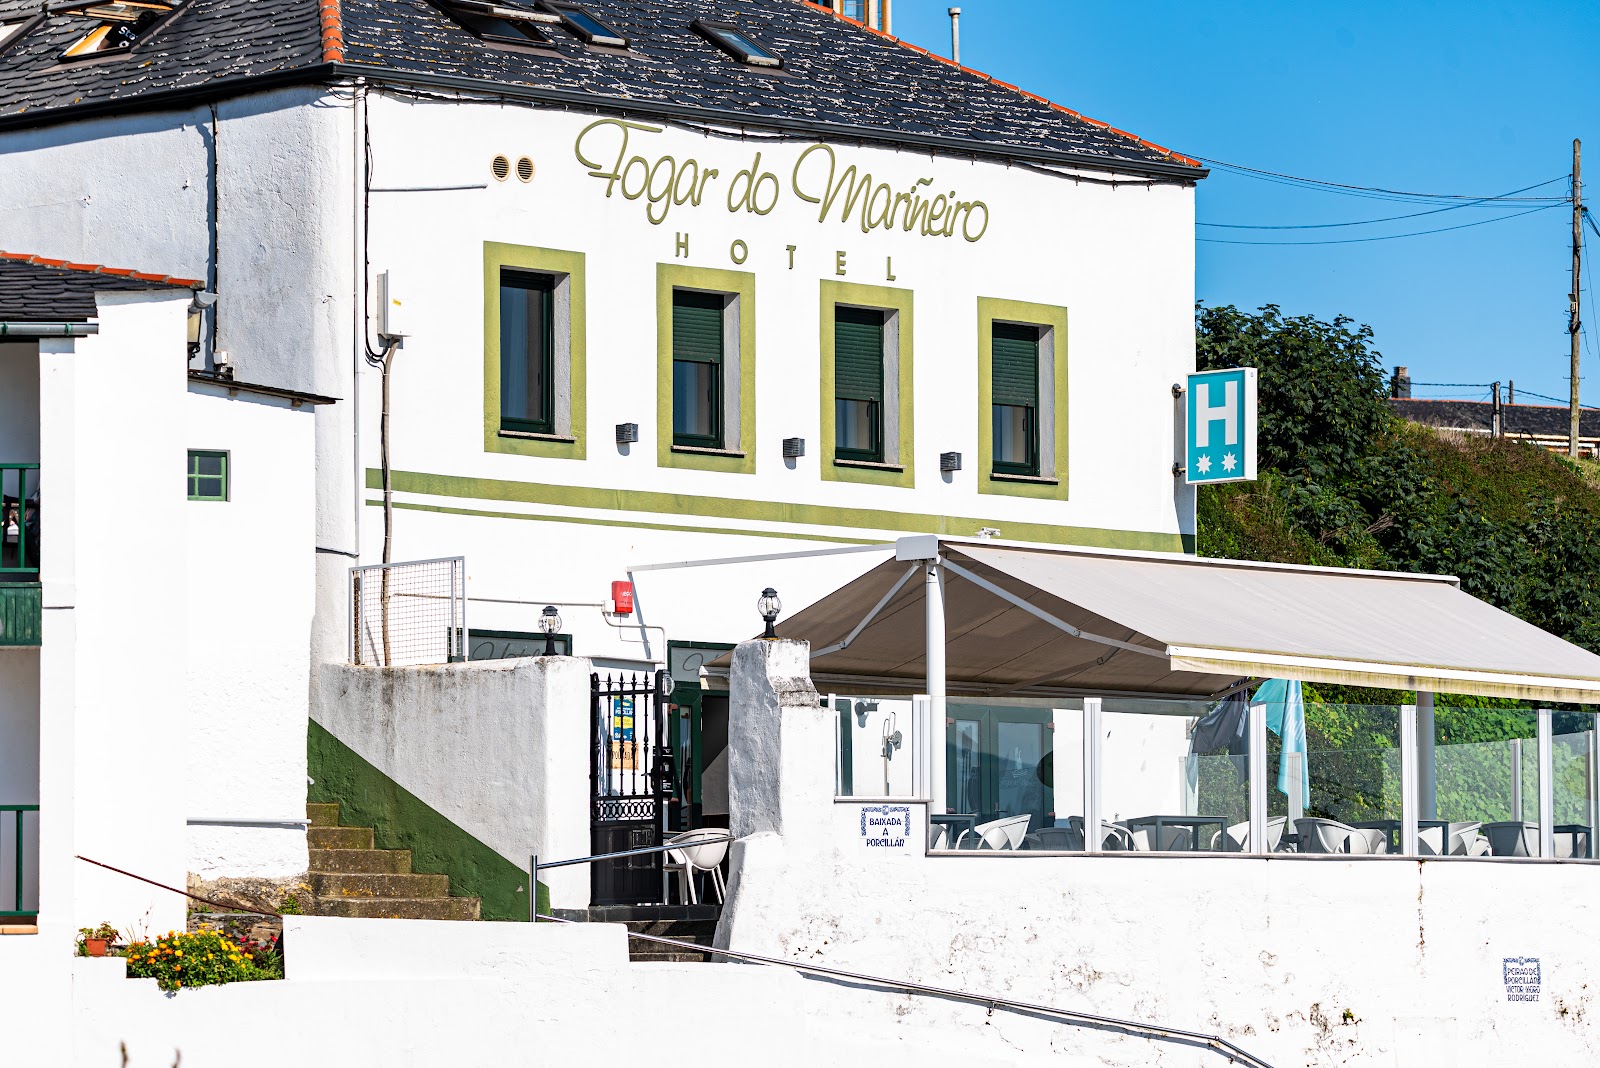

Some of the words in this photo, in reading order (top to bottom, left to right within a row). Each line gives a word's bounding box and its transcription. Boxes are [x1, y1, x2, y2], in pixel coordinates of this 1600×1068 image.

[575, 118, 719, 225] Fogar
[727, 151, 779, 215] do
[793, 143, 989, 242] Mariñeiro
[1195, 381, 1238, 447] H
[869, 817, 902, 826] BAIXADA
[882, 827, 889, 836] A
[866, 836, 905, 847] PORCILLÁN
[1529, 967, 1537, 976] DE
